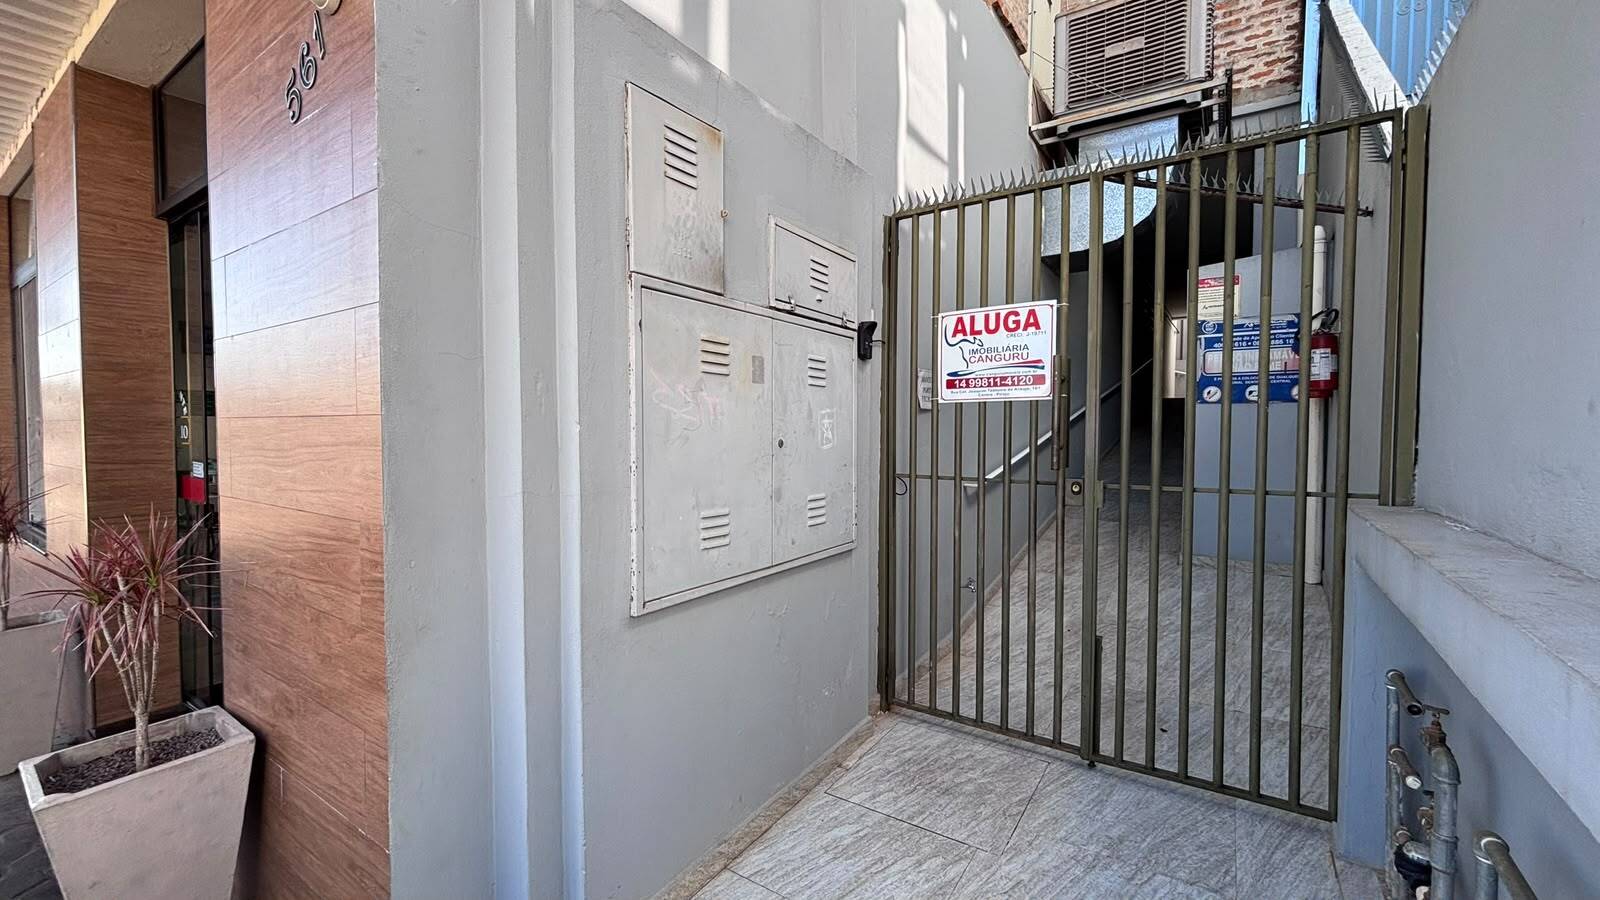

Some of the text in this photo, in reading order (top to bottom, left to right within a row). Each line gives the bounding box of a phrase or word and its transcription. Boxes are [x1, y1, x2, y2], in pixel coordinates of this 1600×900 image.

[284, 9, 326, 125] 561
[951, 308, 1042, 338] ALUGA
[968, 343, 1030, 356] IMOBILIÁRIA
[968, 352, 1030, 364] CANGURU
[954, 376, 1034, 389] 14 99811-4120
